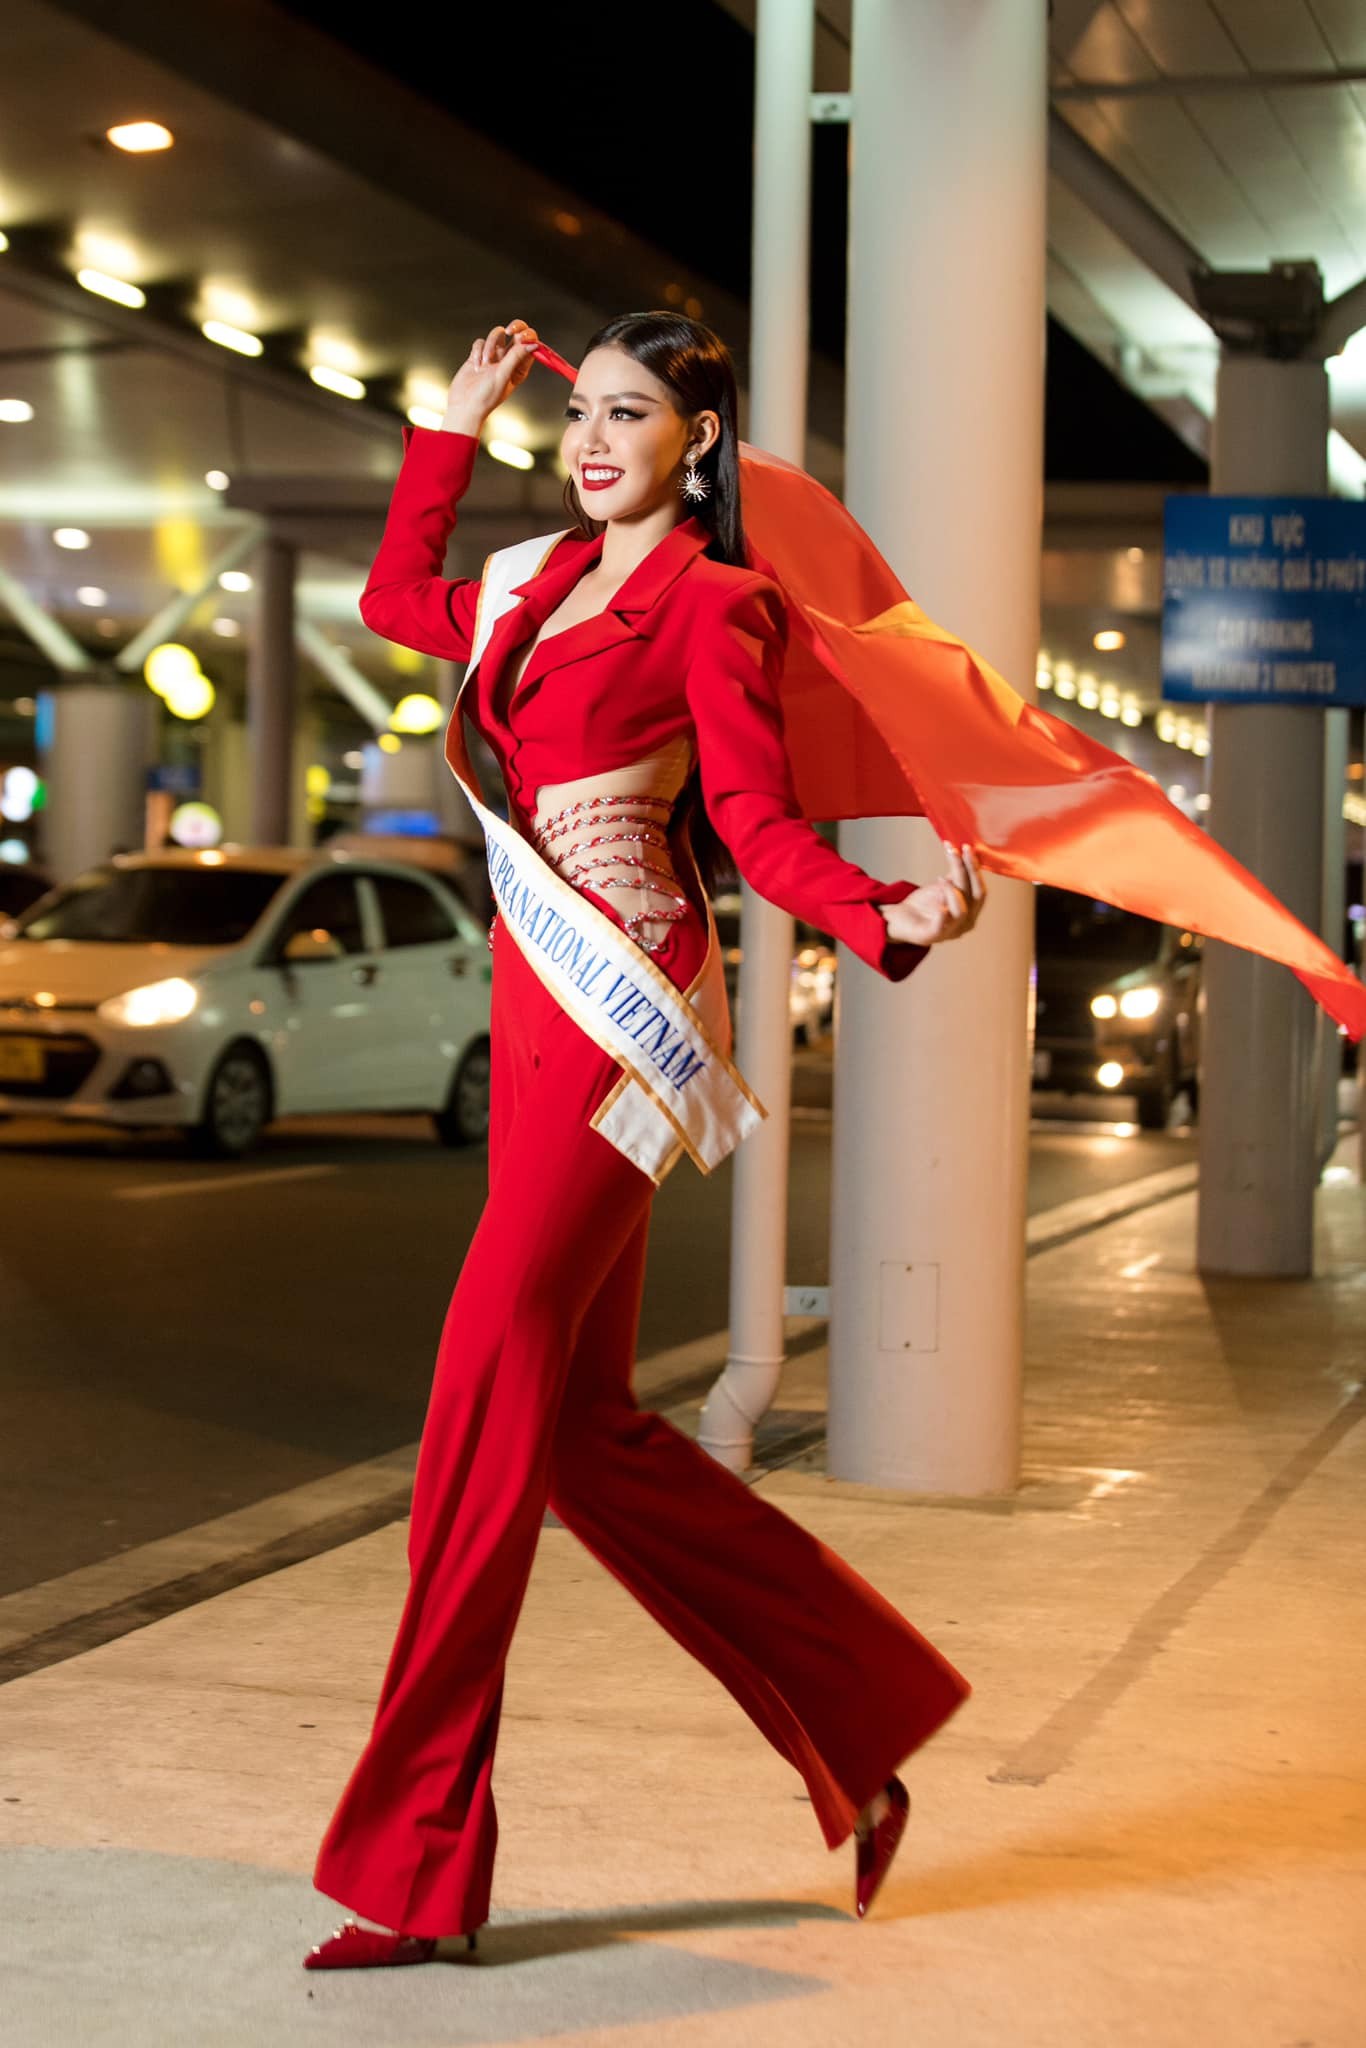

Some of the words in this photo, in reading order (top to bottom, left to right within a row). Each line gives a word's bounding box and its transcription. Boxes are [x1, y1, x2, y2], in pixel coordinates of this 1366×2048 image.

[1229, 515, 1264, 545] KHU
[1271, 510, 1305, 551] VỰC
[1229, 551, 1279, 588] KHÔNG
[1282, 552, 1311, 591] QUÁ
[1249, 618, 1313, 651] PARKING
[1273, 662, 1336, 693] MINUTES
[486, 834, 611, 997] SUPRANATIONAL
[600, 974, 706, 1091] VIETNAM
